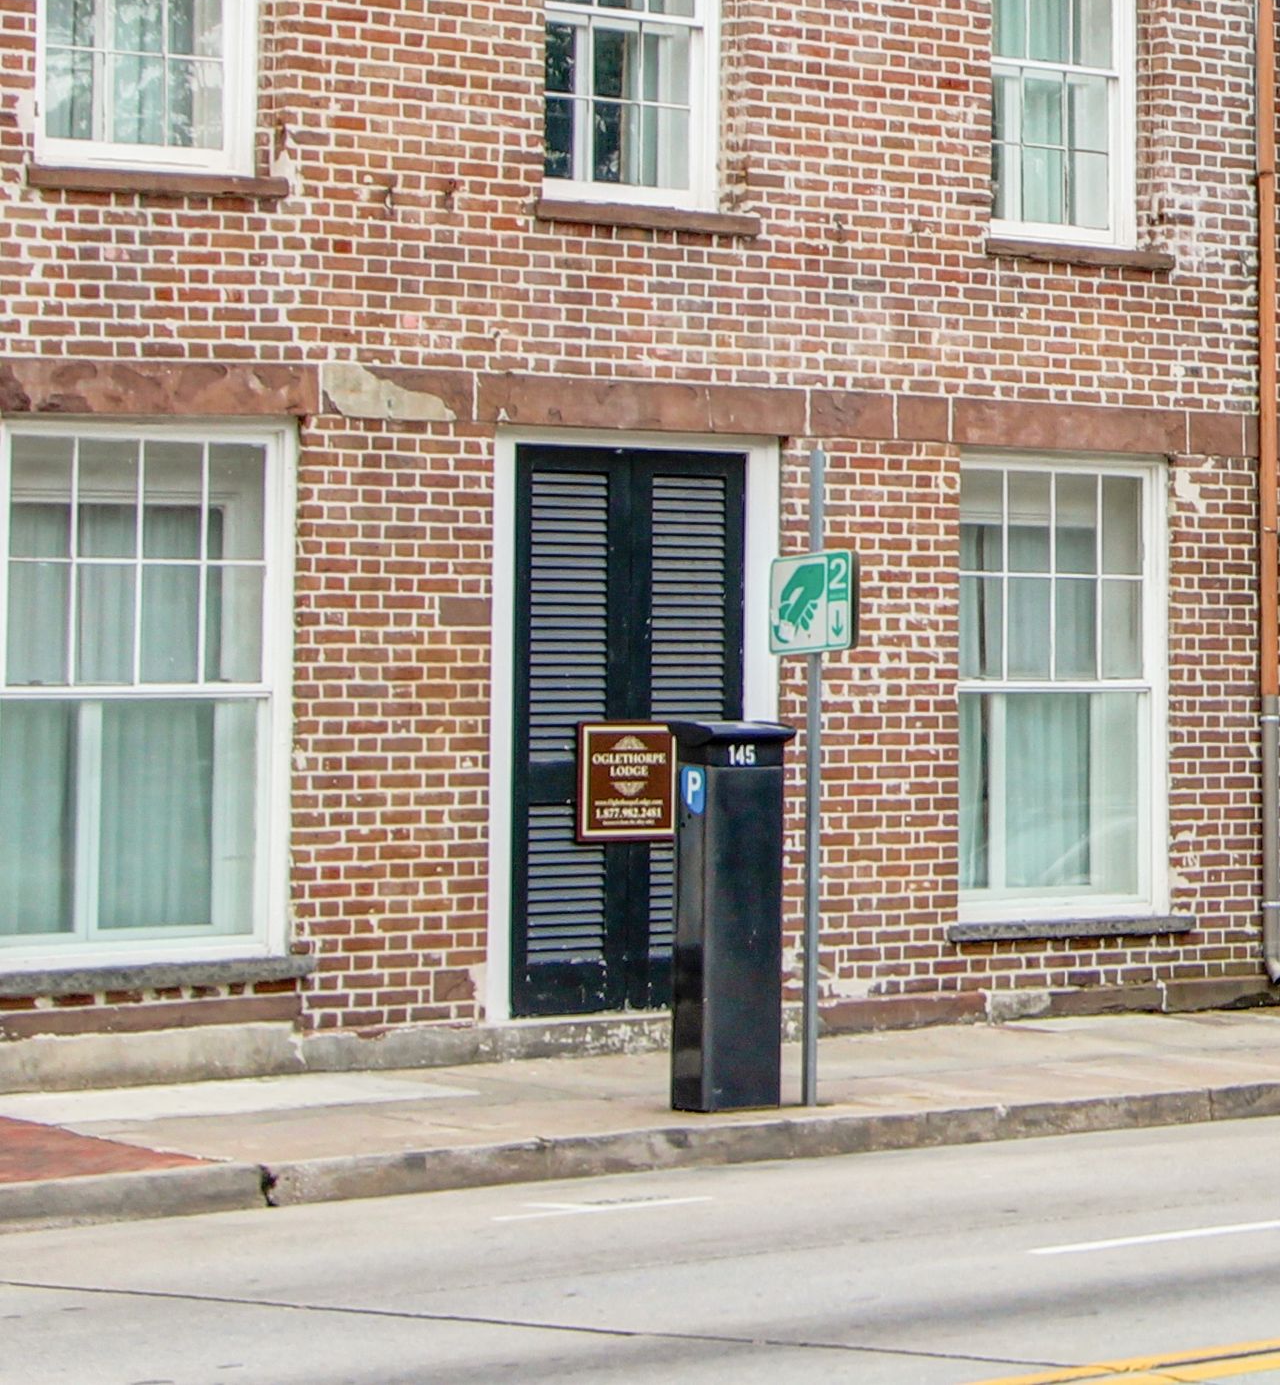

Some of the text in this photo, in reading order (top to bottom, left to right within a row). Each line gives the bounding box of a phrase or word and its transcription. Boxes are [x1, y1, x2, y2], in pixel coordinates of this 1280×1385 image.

[829, 557, 847, 590] 2
[592, 752, 667, 765] OGLETHORPE
[728, 744, 756, 766] 145
[610, 765, 649, 777] LODGE
[687, 770, 702, 805] P
